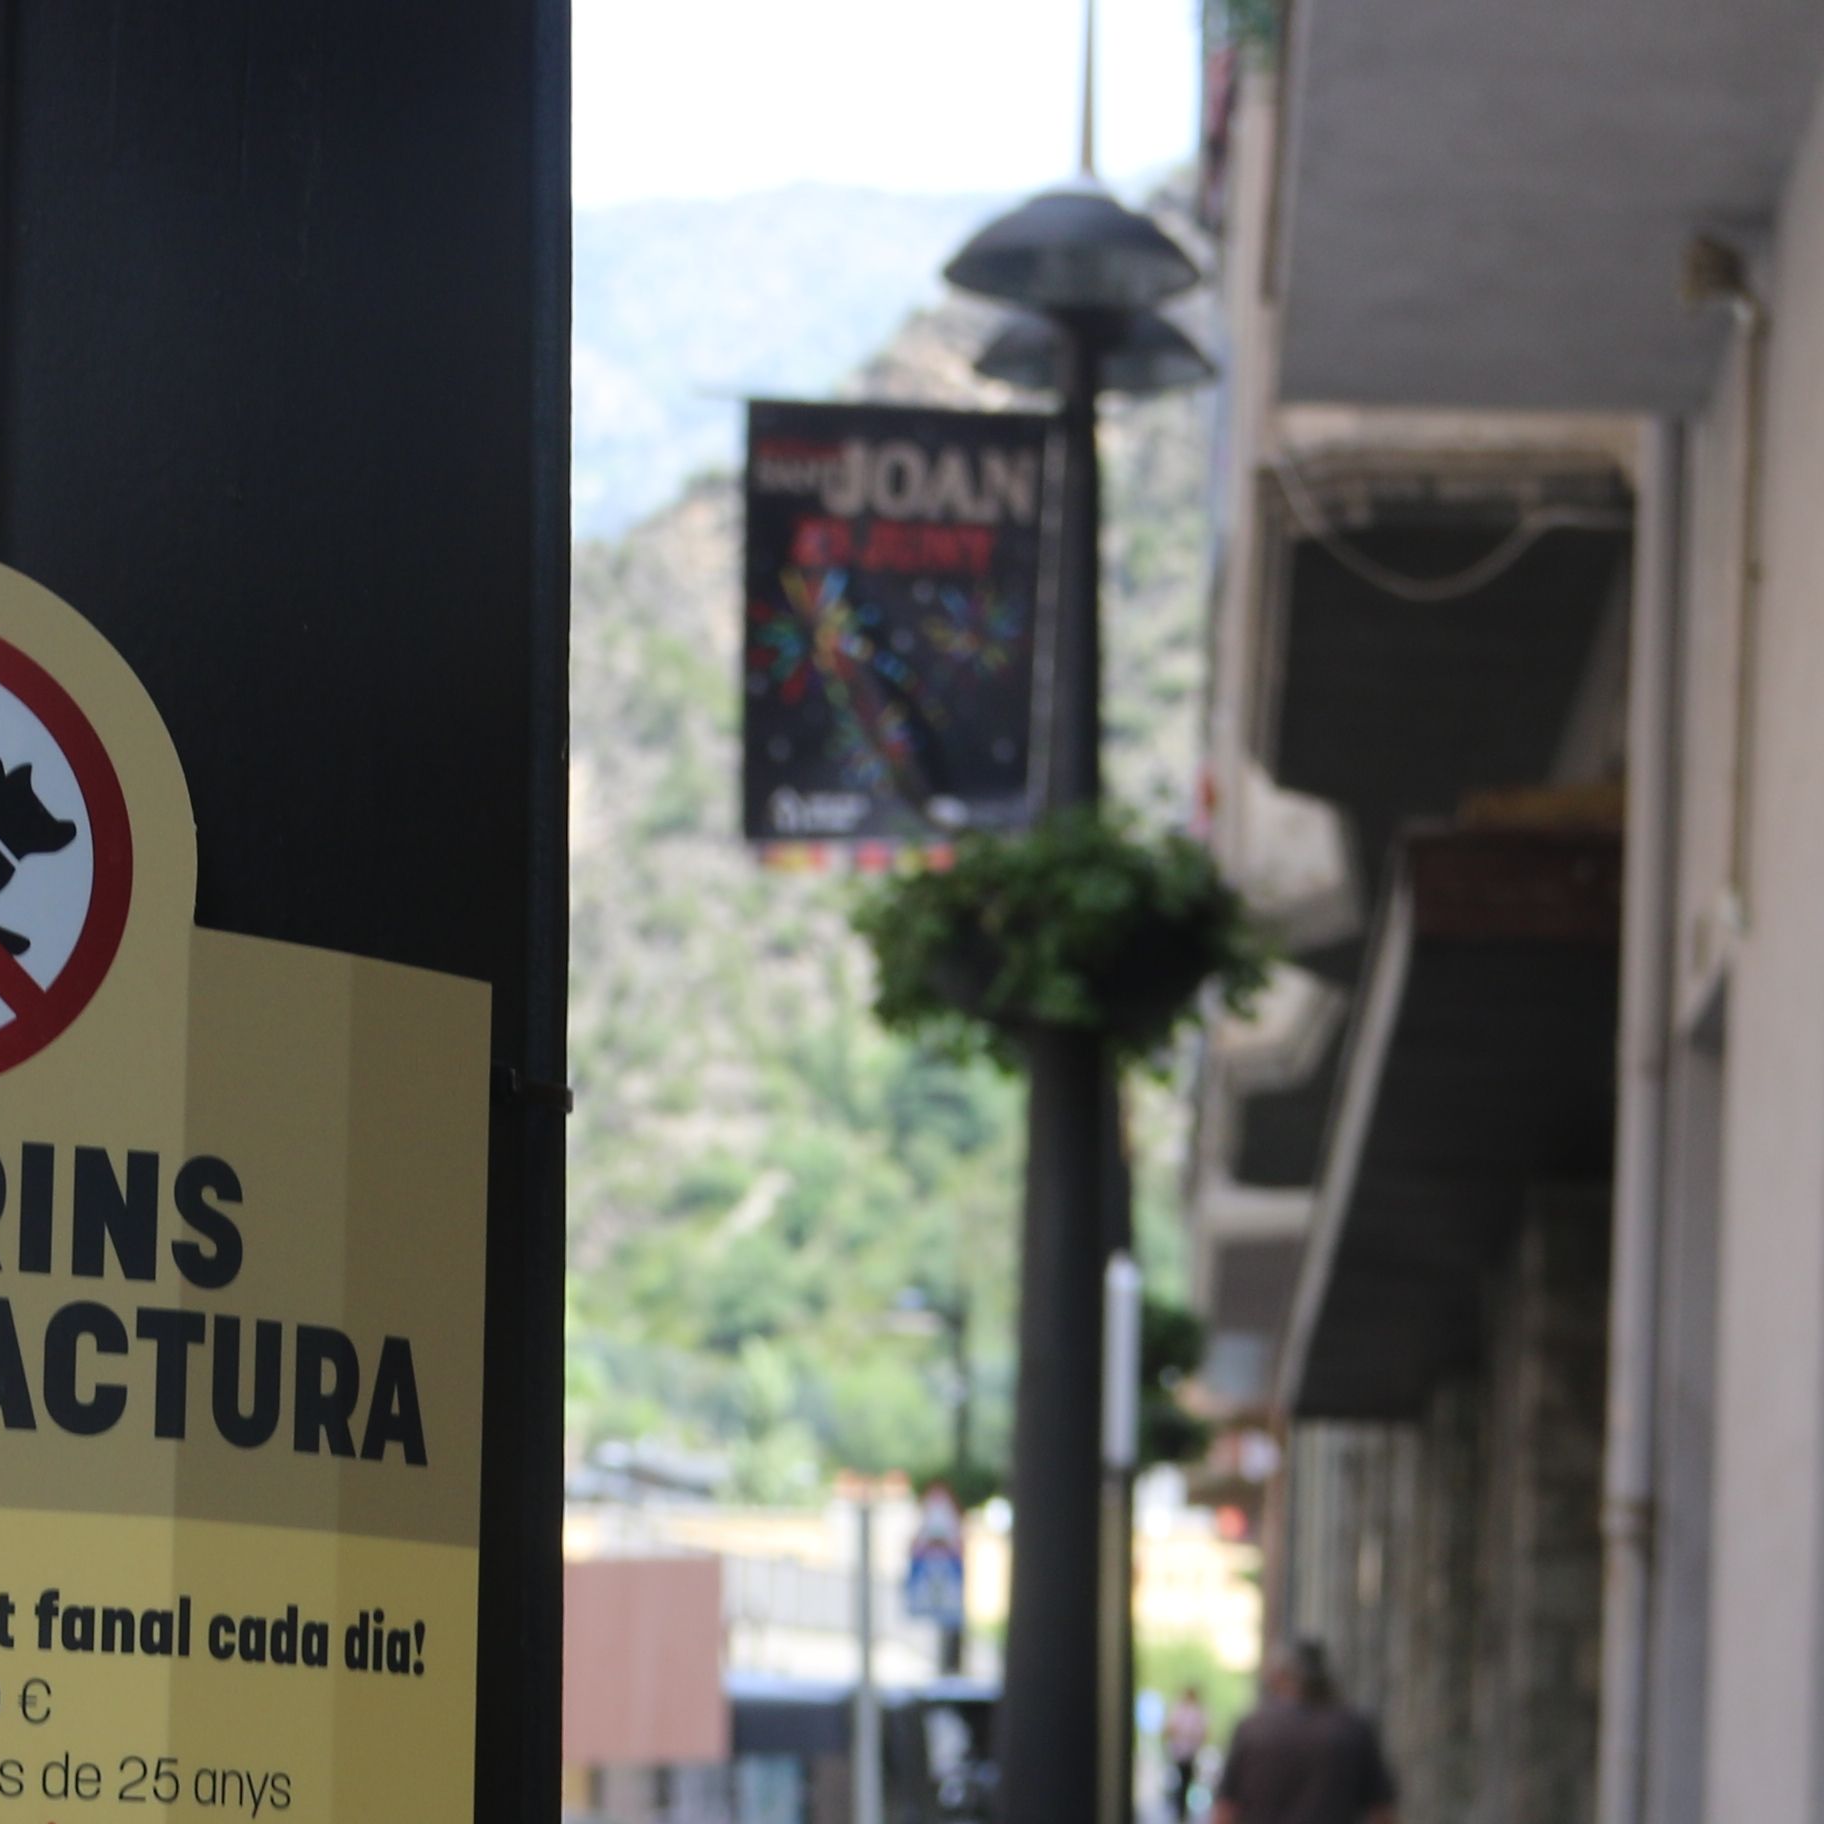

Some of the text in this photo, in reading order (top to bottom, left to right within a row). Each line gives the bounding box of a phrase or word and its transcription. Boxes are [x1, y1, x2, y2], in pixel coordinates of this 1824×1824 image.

[819, 438, 1039, 527] JOAN
[35, 1588, 192, 1657] fanal
[208, 1604, 329, 1668] cada
[343, 1608, 427, 1678] dia!
[18, 1677, 52, 1725] €
[42, 1751, 102, 1801] de
[117, 1755, 180, 1803] 25
[193, 1765, 292, 1820] anys
